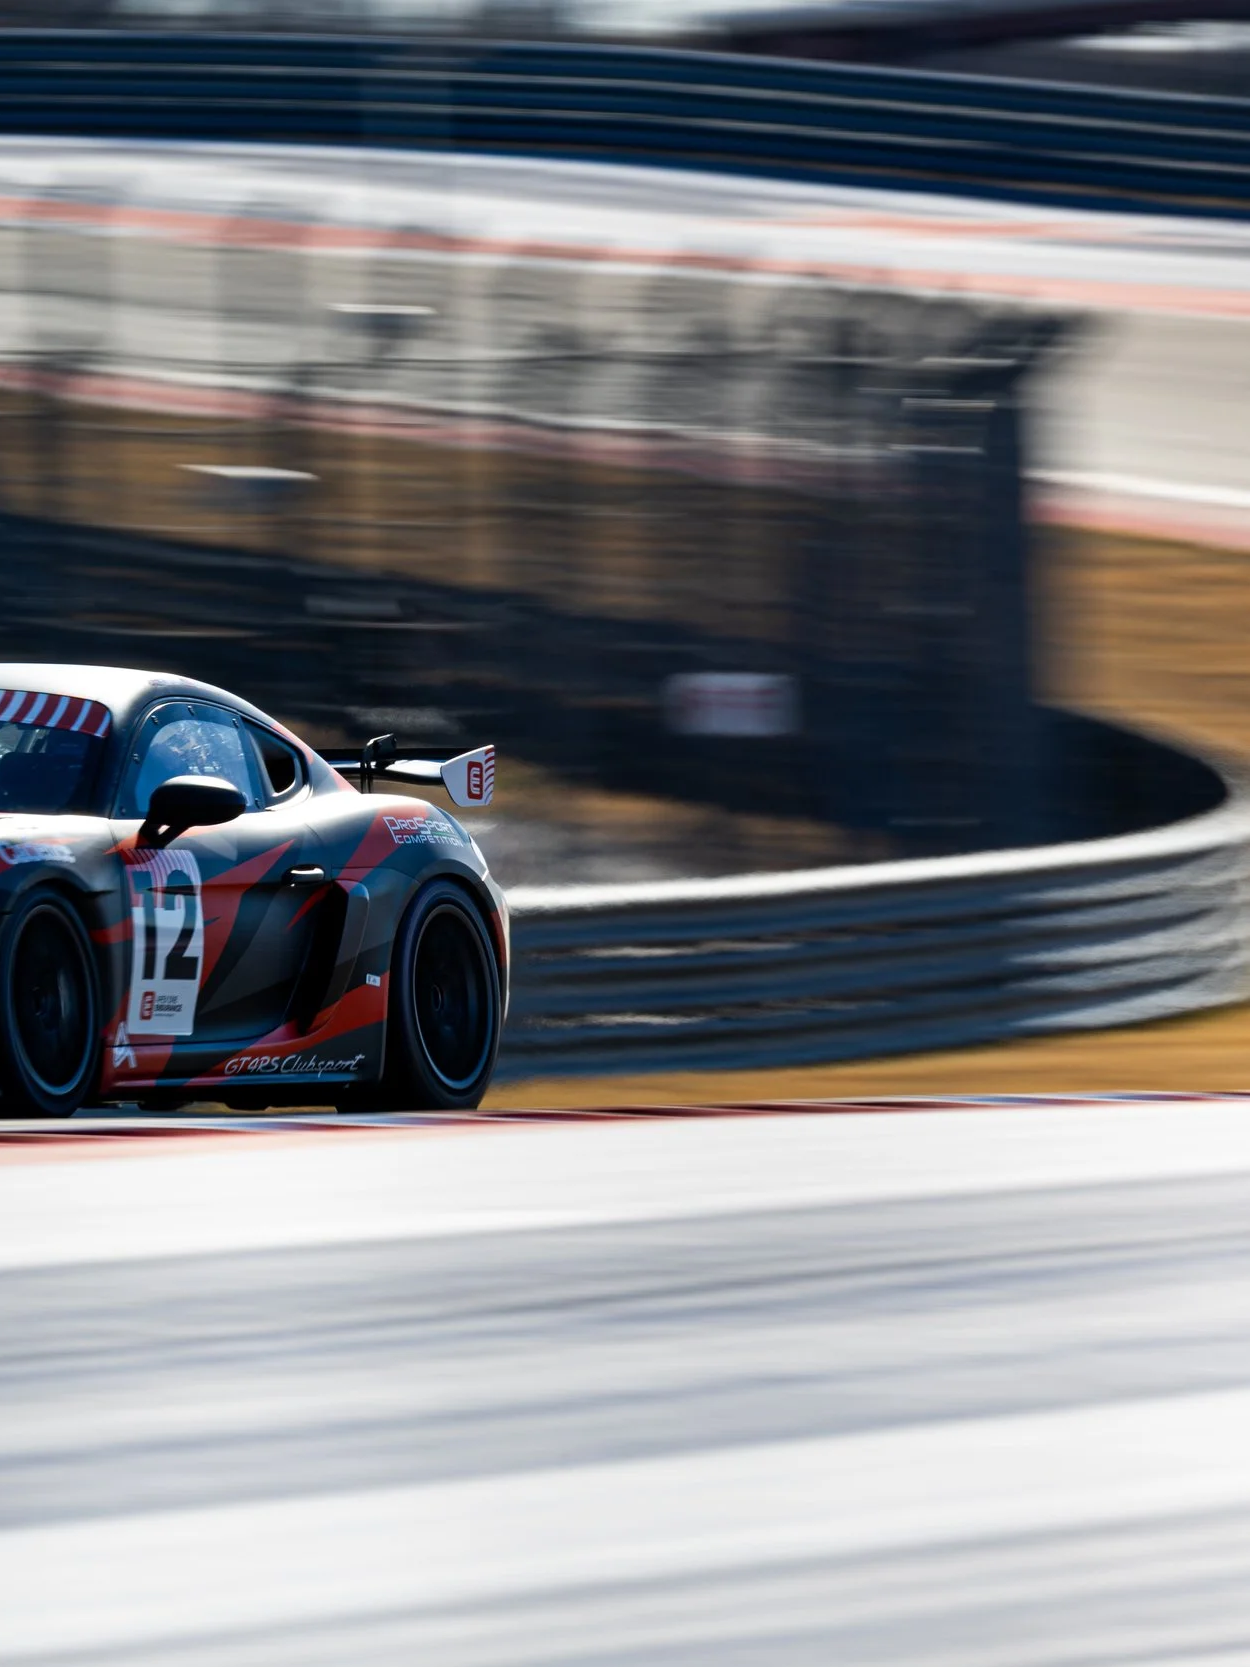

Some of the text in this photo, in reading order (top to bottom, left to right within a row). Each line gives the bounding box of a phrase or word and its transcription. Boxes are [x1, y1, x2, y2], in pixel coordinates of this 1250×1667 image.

[395, 834, 464, 848] COMPETITION
[131, 869, 200, 980] 12
[281, 1054, 365, 1078] Clubsport
